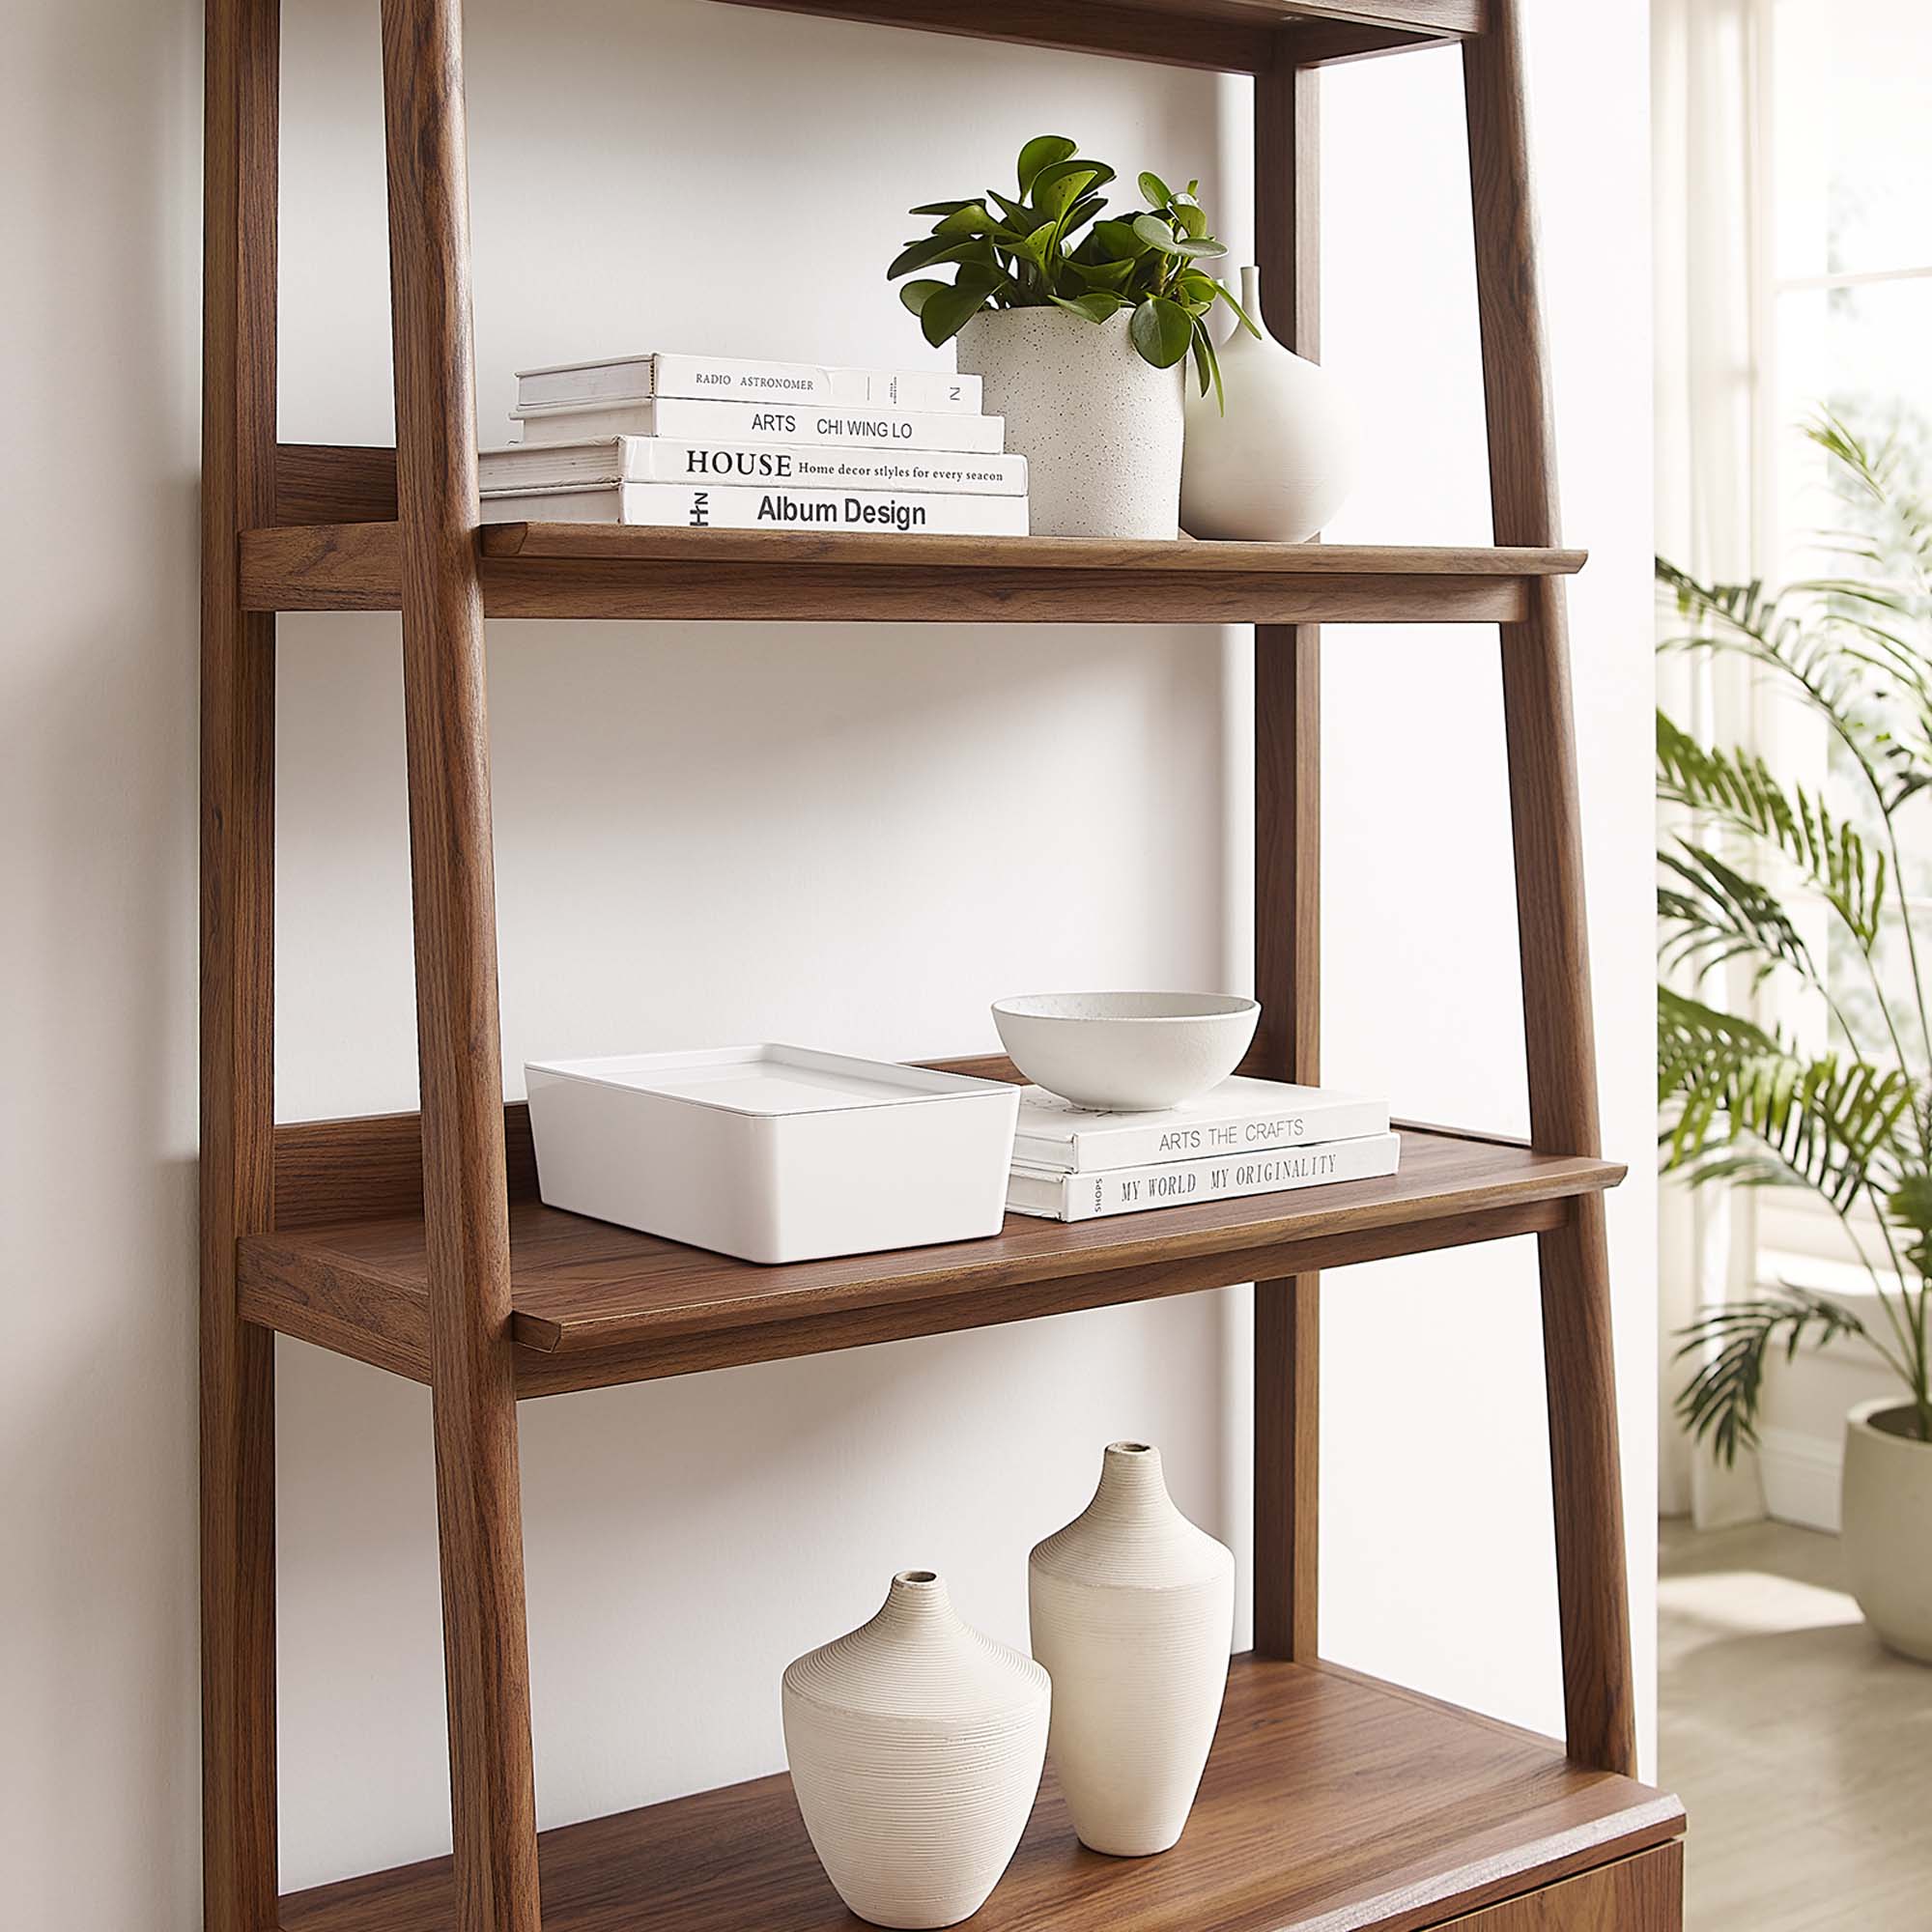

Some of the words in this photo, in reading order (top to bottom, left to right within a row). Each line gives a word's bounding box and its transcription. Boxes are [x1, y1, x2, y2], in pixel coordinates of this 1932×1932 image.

[696, 373, 731, 385] RADIO
[740, 376, 814, 390] ASTRONOMER
[752, 413, 796, 433] ARTS
[816, 418, 841, 436] CHI
[846, 420, 889, 438] WING
[893, 422, 913, 439] LO
[686, 450, 792, 477] HOUSE
[798, 462, 835, 474] Home
[838, 464, 871, 476] decor
[912, 468, 929, 478] for
[932, 471, 963, 483] every
[966, 472, 1004, 482] seacon
[756, 495, 838, 523] Album
[844, 497, 926, 531] Design
[1159, 1130, 1201, 1151] ARTS
[1208, 1125, 1237, 1146] THE
[1245, 1119, 1304, 1142] CRAFTS
[1121, 1180, 1141, 1203] MY
[1148, 1173, 1197, 1197] WORLD
[1210, 1168, 1230, 1190] MY
[1236, 1153, 1337, 1186] ORIGINALITY
[1094, 1178, 1103, 1213] SHOPS
